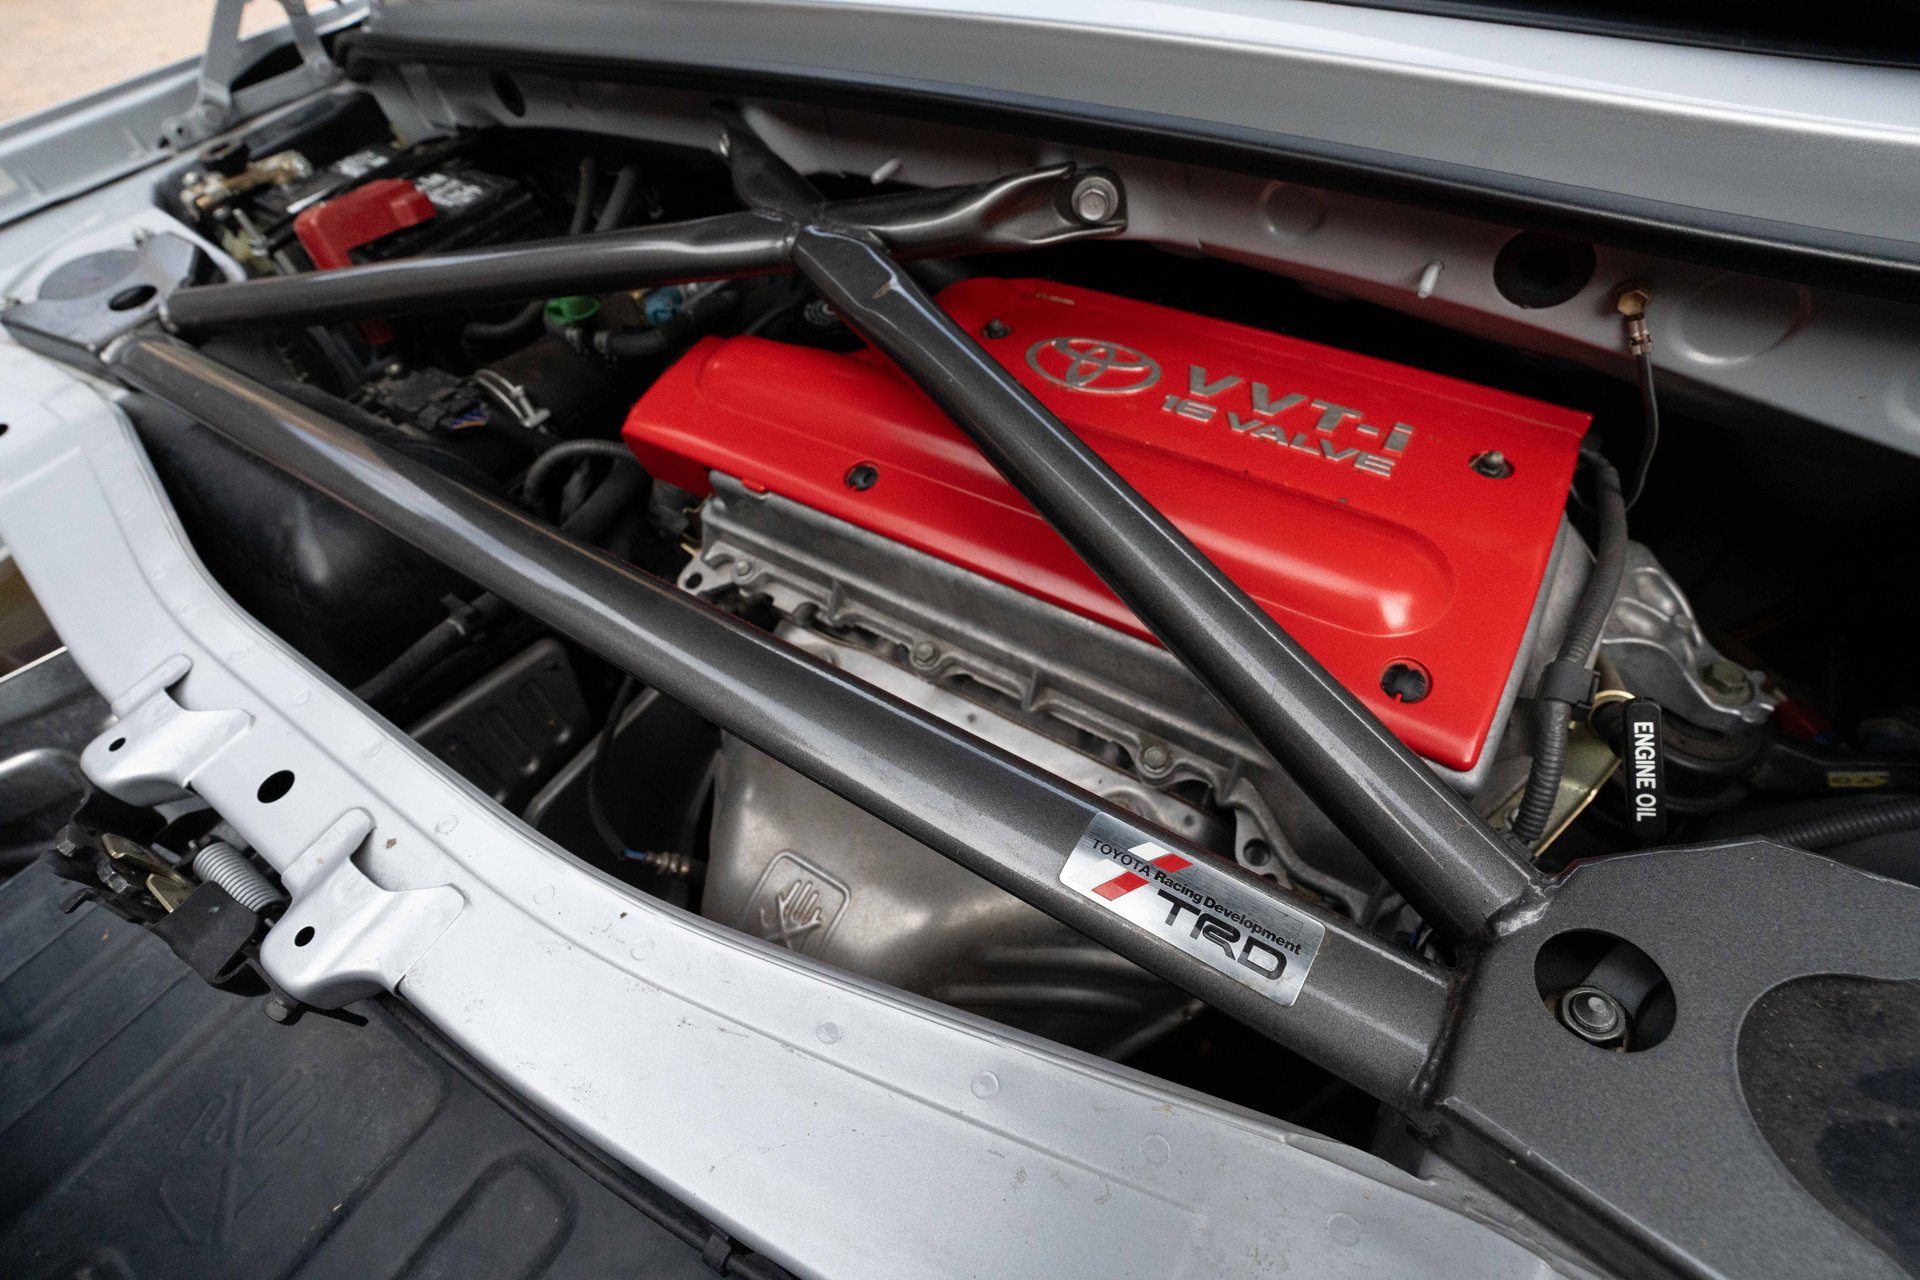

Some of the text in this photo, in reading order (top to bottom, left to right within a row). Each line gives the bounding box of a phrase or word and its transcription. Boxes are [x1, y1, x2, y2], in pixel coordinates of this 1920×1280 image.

[1162, 394, 1395, 478] 16 VALVE
[1189, 365, 1413, 453] VVT-i
[1634, 722, 1657, 822] ENGINE OIL
[1092, 838, 1302, 955] TOYOTA Racing Development
[1157, 889, 1287, 980] TRD
